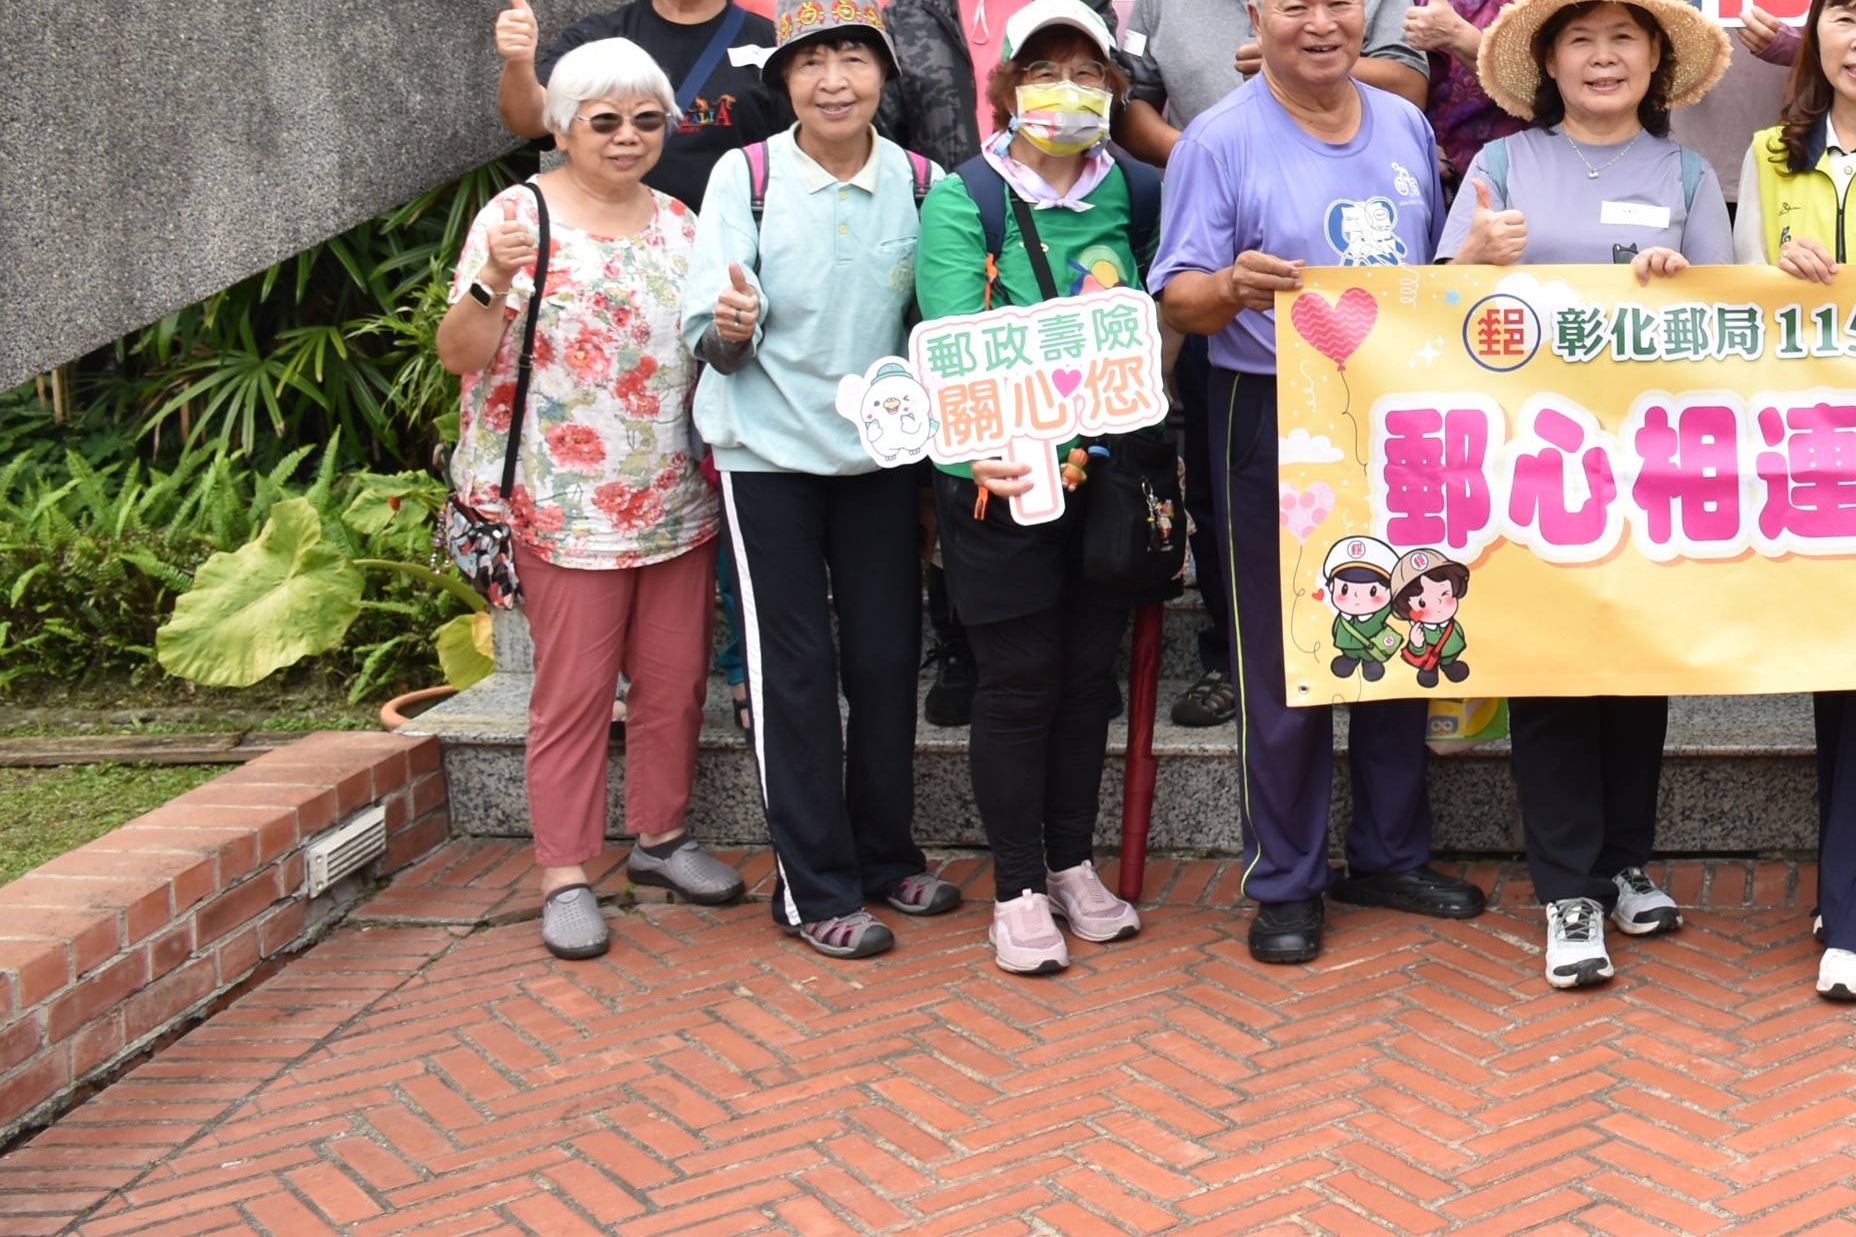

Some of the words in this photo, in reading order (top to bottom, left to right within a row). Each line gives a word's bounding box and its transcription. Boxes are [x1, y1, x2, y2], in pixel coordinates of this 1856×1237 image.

[926, 304, 1144, 379] 郵政壽險
[937, 355, 1151, 448] 關心您
